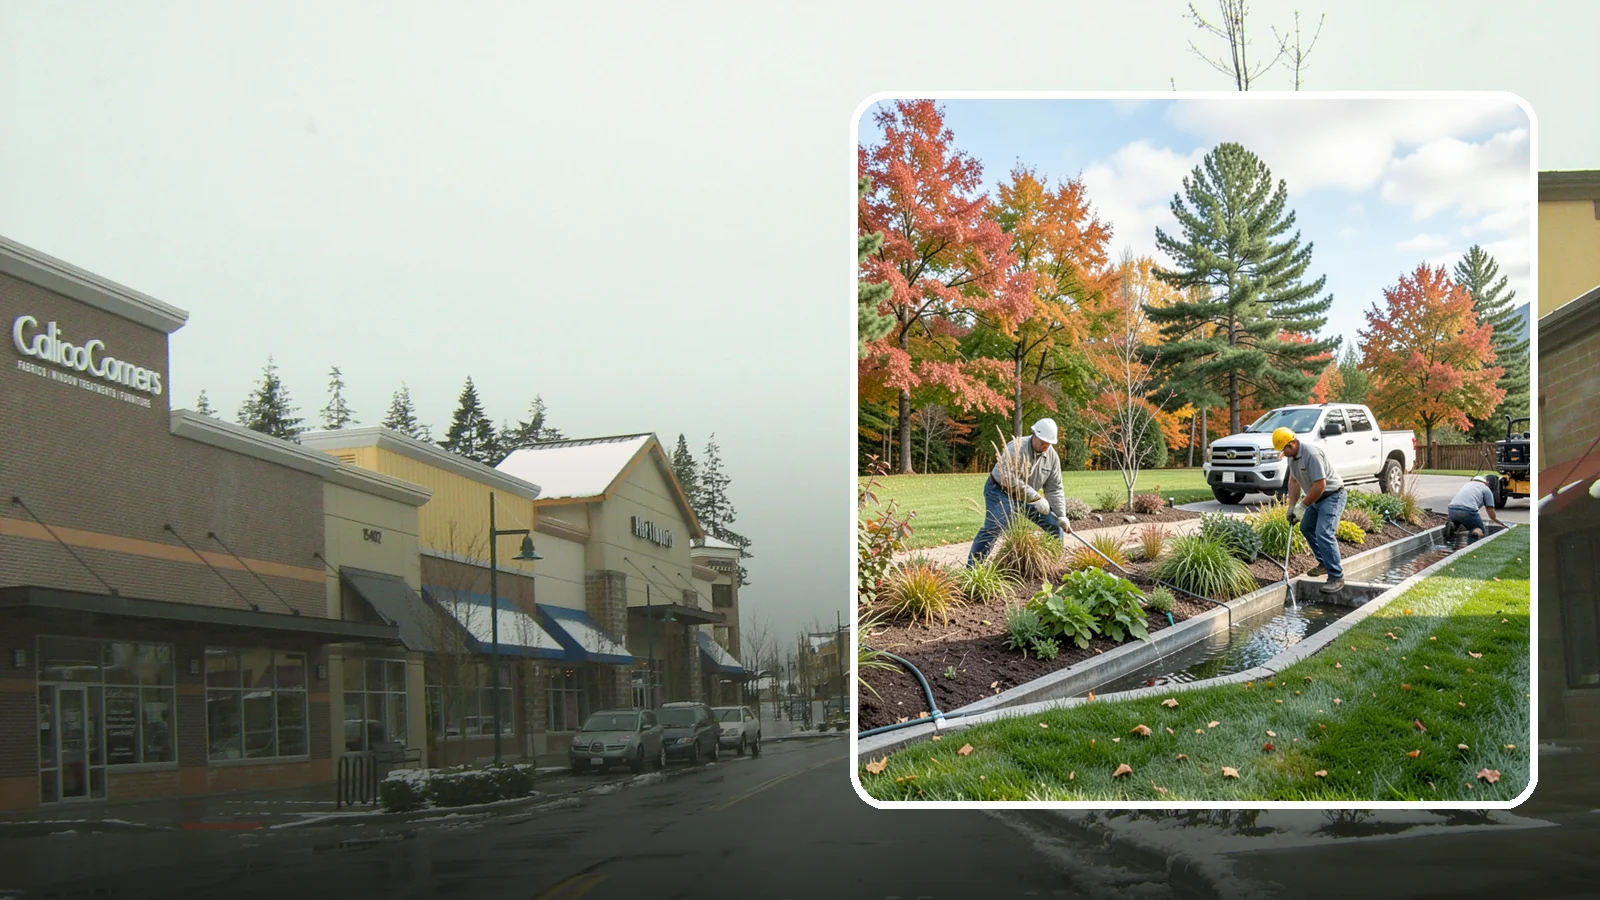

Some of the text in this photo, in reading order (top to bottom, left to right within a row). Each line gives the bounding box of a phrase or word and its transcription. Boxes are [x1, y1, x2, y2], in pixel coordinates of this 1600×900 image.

[16, 360, 47, 377] FABRICS
[50, 369, 78, 387] WINDOW
[79, 378, 117, 398] TREATMENTS
